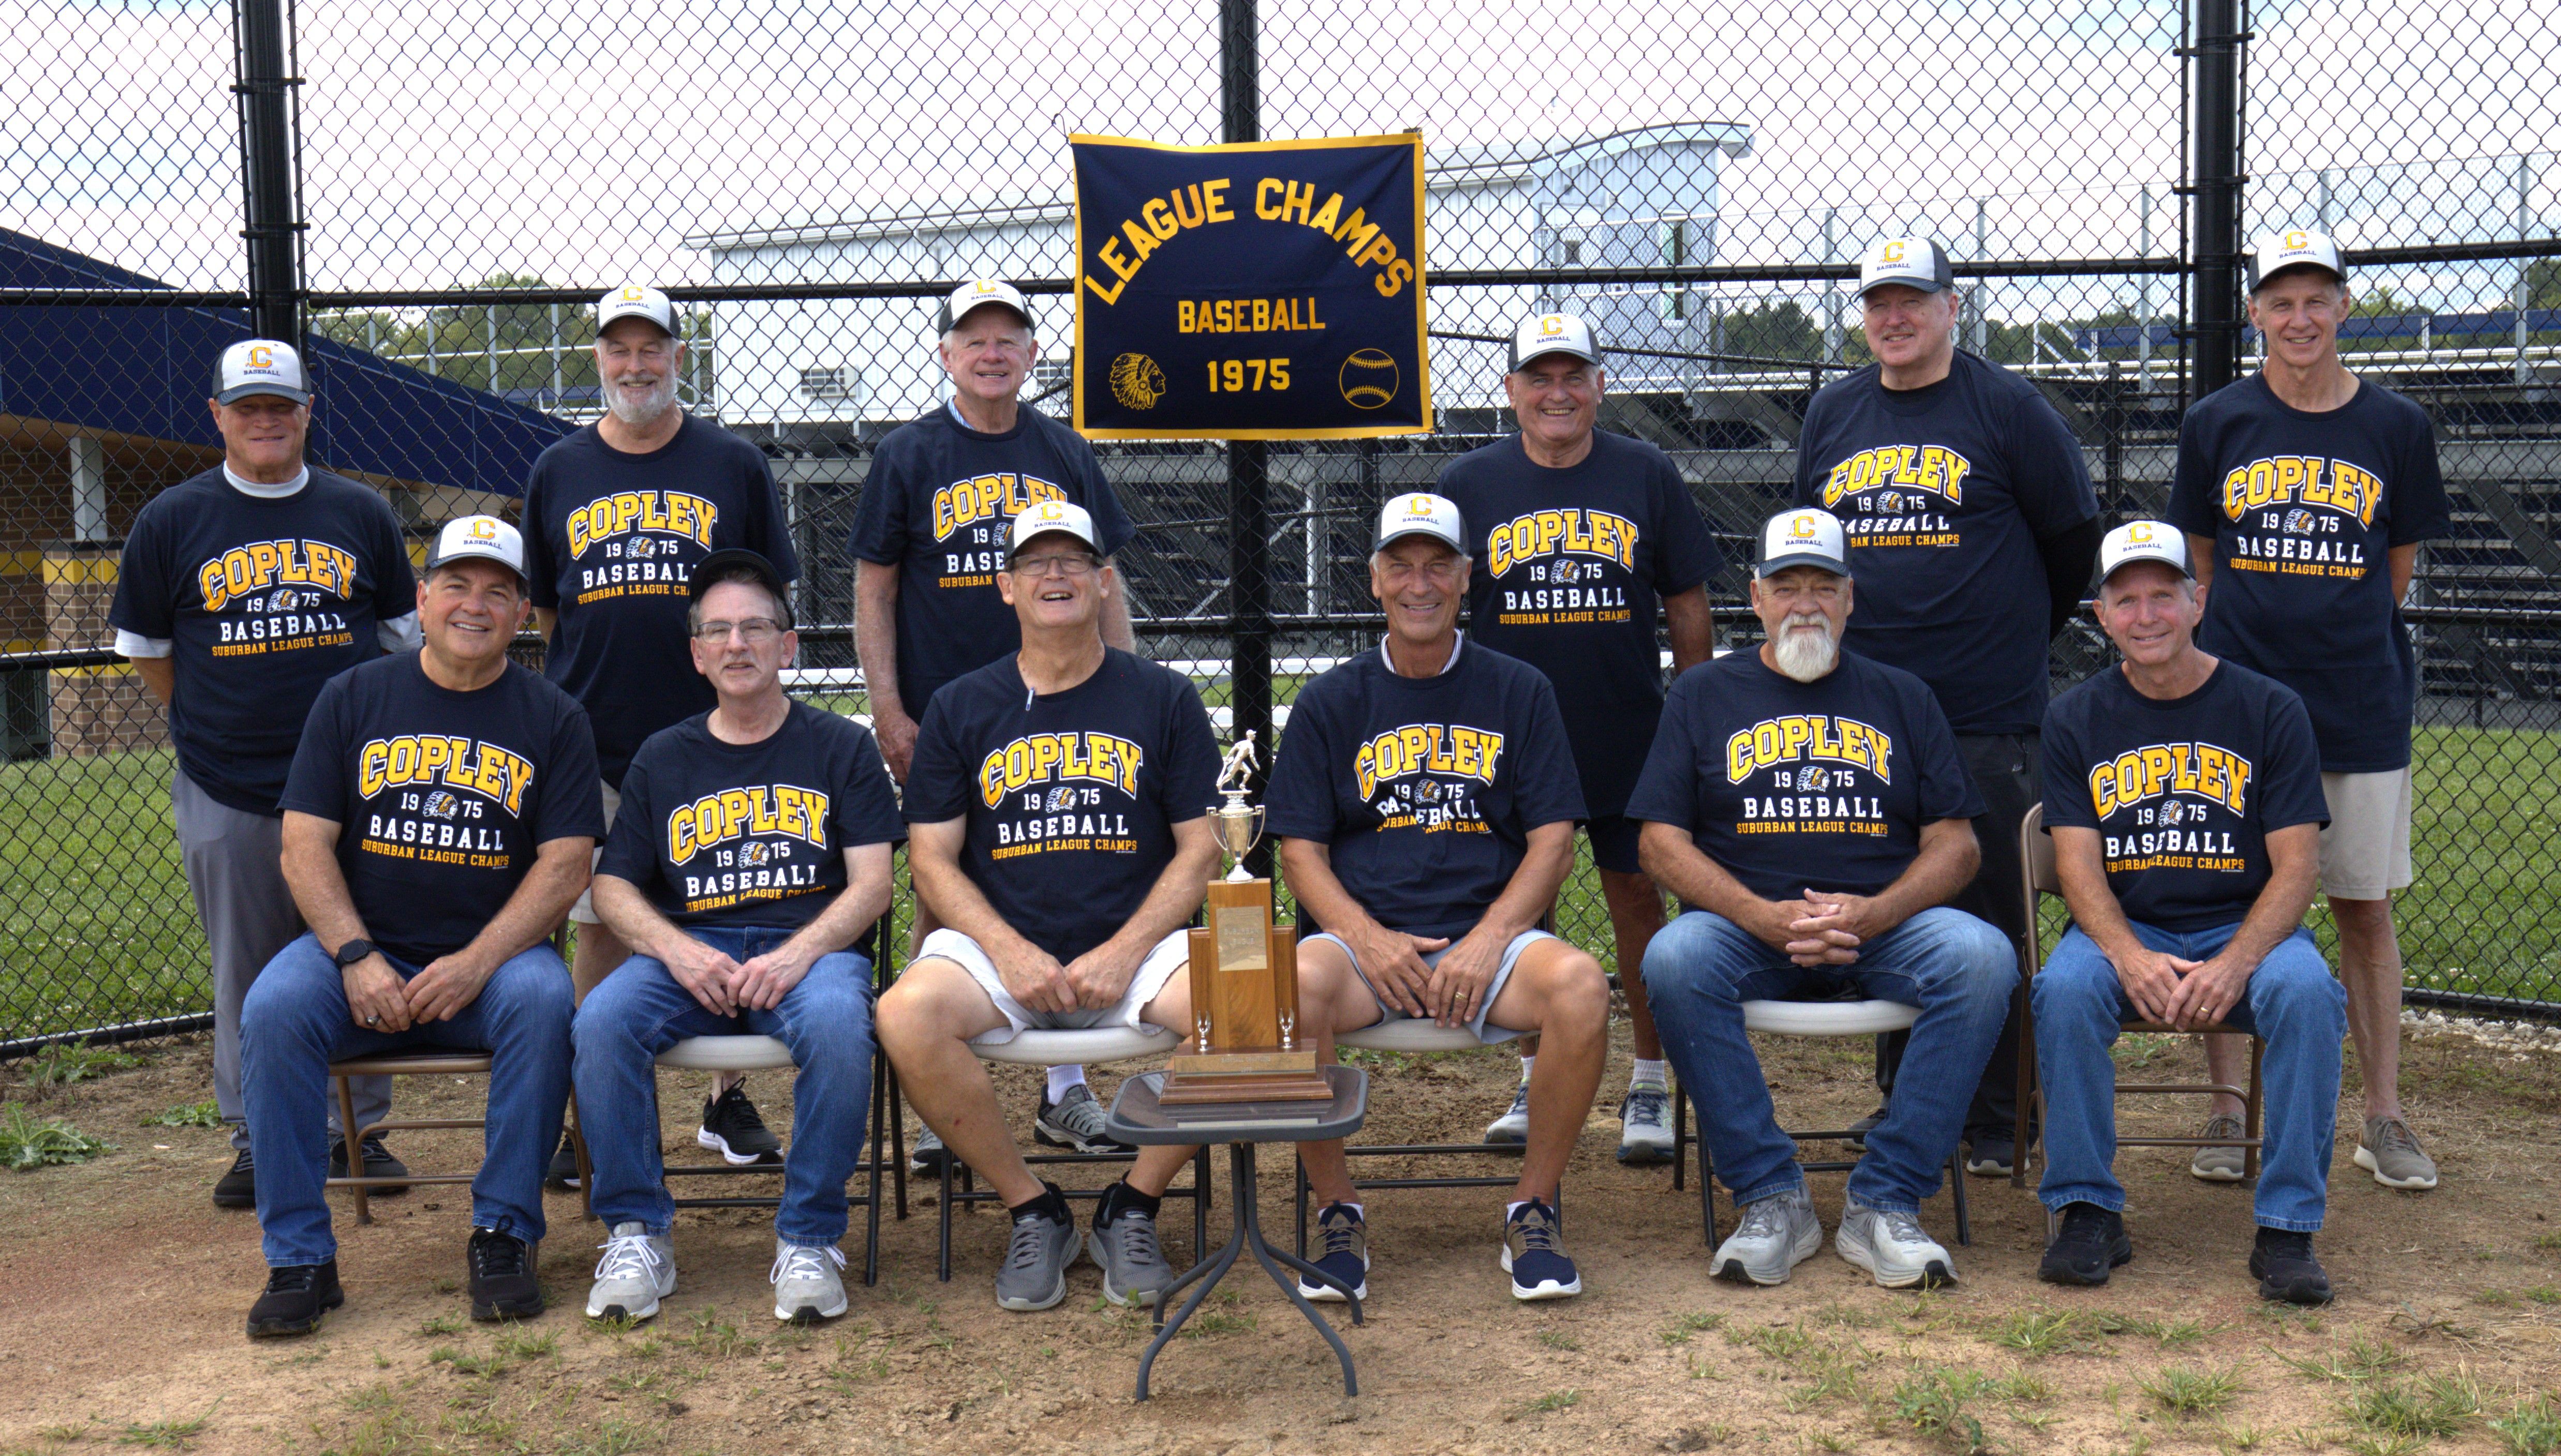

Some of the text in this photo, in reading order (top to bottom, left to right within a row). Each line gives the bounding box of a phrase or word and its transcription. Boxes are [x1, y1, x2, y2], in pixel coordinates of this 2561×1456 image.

[1084, 177, 1414, 305] LEAGUE CHAMPS
[2286, 232, 2307, 249] C
[1885, 242, 1904, 263] C
[624, 287, 642, 301] C
[976, 280, 996, 293] C
[1178, 298, 1325, 333] BASEBALL
[1543, 317, 1562, 336] C
[252, 347, 272, 368] C
[1208, 358, 1290, 392] 1975
[1823, 444, 1970, 509] COPLEY
[1858, 496, 1926, 511] 19 75
[2223, 455, 2384, 532] COPLEY
[1042, 503, 1062, 521] C
[1412, 497, 1431, 515] C
[474, 519, 495, 540] C
[567, 491, 718, 561] COPLEY
[1795, 516, 1815, 538] C
[1840, 514, 1949, 533] ASEBALL
[2262, 513, 2339, 532] 19 75
[973, 529, 987, 543] 19
[1488, 509, 1639, 579] COPLEY
[1873, 536, 1912, 546] LEAGUE
[1916, 534, 1960, 545] CHAMPS
[2131, 524, 2152, 543] C
[464, 540, 502, 549] BASEBALL
[606, 541, 677, 557] 19 75
[2123, 543, 2162, 552] BASEBALL
[2238, 536, 2363, 563] BASEBALL
[946, 552, 1004, 573] BASE
[1530, 563, 1602, 581] 19 75
[2230, 558, 2367, 577] SUBURBAN LEAGUE CHAMP
[199, 539, 356, 612] COPLEY
[583, 563, 697, 589] BASEBAL
[940, 575, 993, 587] SUBURBAN
[247, 593, 321, 612] 19 75
[578, 585, 624, 604] SUBURBAN
[629, 585, 669, 595] LEAGUE
[1504, 587, 1625, 610] BASEBALL
[1500, 610, 1631, 624] SUBURBAN LEAGUE CHAMPS
[220, 614, 346, 642] BASEBALL
[212, 632, 353, 656] SUBURBAN LEAGUE CHAMPS
[1727, 715, 1892, 785] COPLEY
[979, 731, 1143, 810] COPLEY
[1354, 724, 1504, 803] COPLEY
[359, 734, 534, 819] COPLEY
[1774, 771, 1854, 787] 19 75
[2089, 742, 2251, 822] COPLEY
[1024, 789, 1100, 810] 19 75
[1395, 784, 1464, 799] 19 75
[401, 792, 483, 818] 19 75
[1744, 797, 1883, 818] BASEBALL
[2138, 805, 2207, 825] 19 75
[370, 815, 503, 851] BASEBALL
[668, 784, 828, 866] COPLEY
[998, 814, 1129, 844] BASEBALL
[1737, 822, 1888, 834] SUBURBAN LEAGUE CHAMPS
[362, 839, 509, 867] SUBURBAN LEAGUE CHAMPS
[992, 839, 1137, 859] SUBURBAN LEAGUE CHAMPS
[2107, 830, 2234, 857] BASEBALL
[716, 842, 790, 867] 19 75
[2149, 855, 2193, 868] LEAGUE
[2197, 858, 2245, 870] CHAMPS
[686, 865, 816, 897] BASEBALL
[686, 895, 736, 912] UBURBAN
[741, 889, 782, 901] LEAGUE
